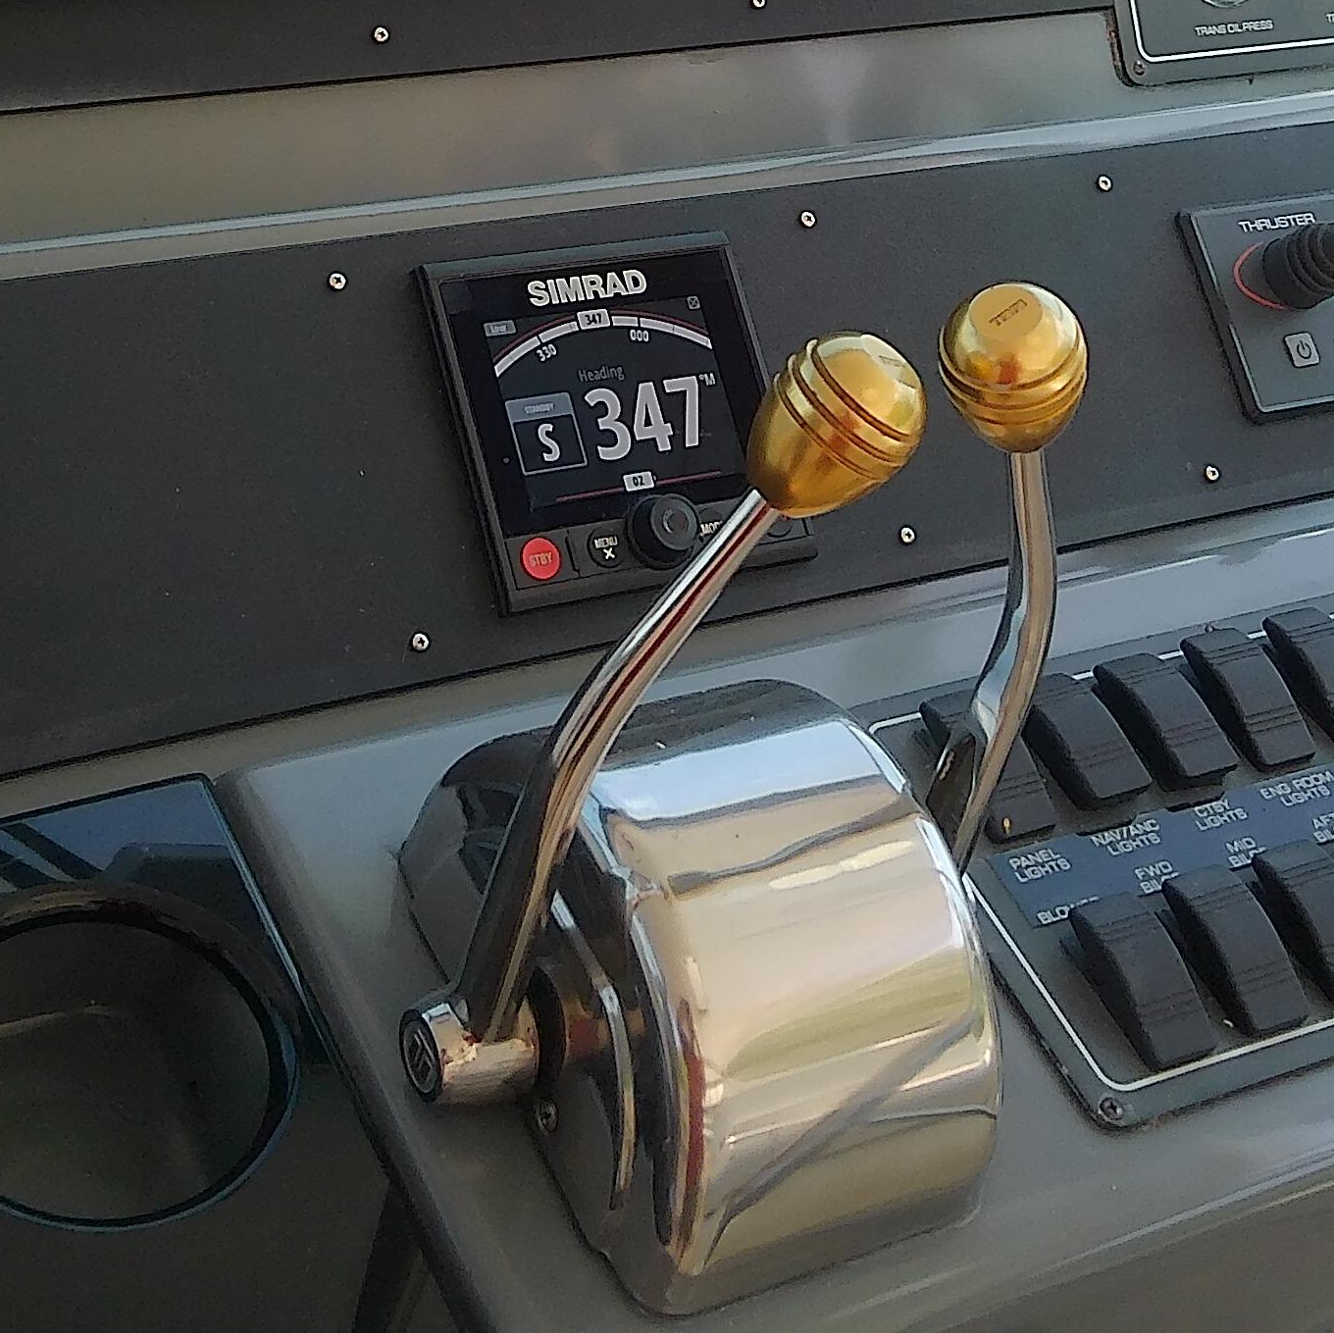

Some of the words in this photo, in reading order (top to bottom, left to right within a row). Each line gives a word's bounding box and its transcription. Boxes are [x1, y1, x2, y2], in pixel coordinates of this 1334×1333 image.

[1194, 24, 1227, 37] TRANS
[1227, 23, 1242, 34] OIL
[1242, 19, 1274, 32] PRESS
[1238, 212, 1316, 234] THRUSTER
[527, 269, 647, 307] SIMRAD
[584, 312, 602, 326] 347
[536, 343, 557, 361] 330
[578, 365, 625, 384] Heading
[584, 376, 700, 462] 347
[538, 423, 561, 462] S
[594, 535, 618, 549] MENU
[529, 553, 553, 565] STBY
[1259, 783, 1291, 801] ENG
[1291, 770, 1334, 793] ROOM
[1279, 784, 1332, 808] LIGHTS
[1195, 807, 1248, 832] LIGHTS
[1091, 818, 1160, 848] NAV/ANC
[1108, 832, 1161, 857] LIGHTS
[1225, 836, 1258, 855] MID
[1009, 847, 1061, 870] PANEL
[1228, 846, 1266, 870] BIL
[1015, 858, 1071, 884] LIGHTS
[1134, 860, 1173, 880] FWD
[1139, 872, 1180, 895] BIL
